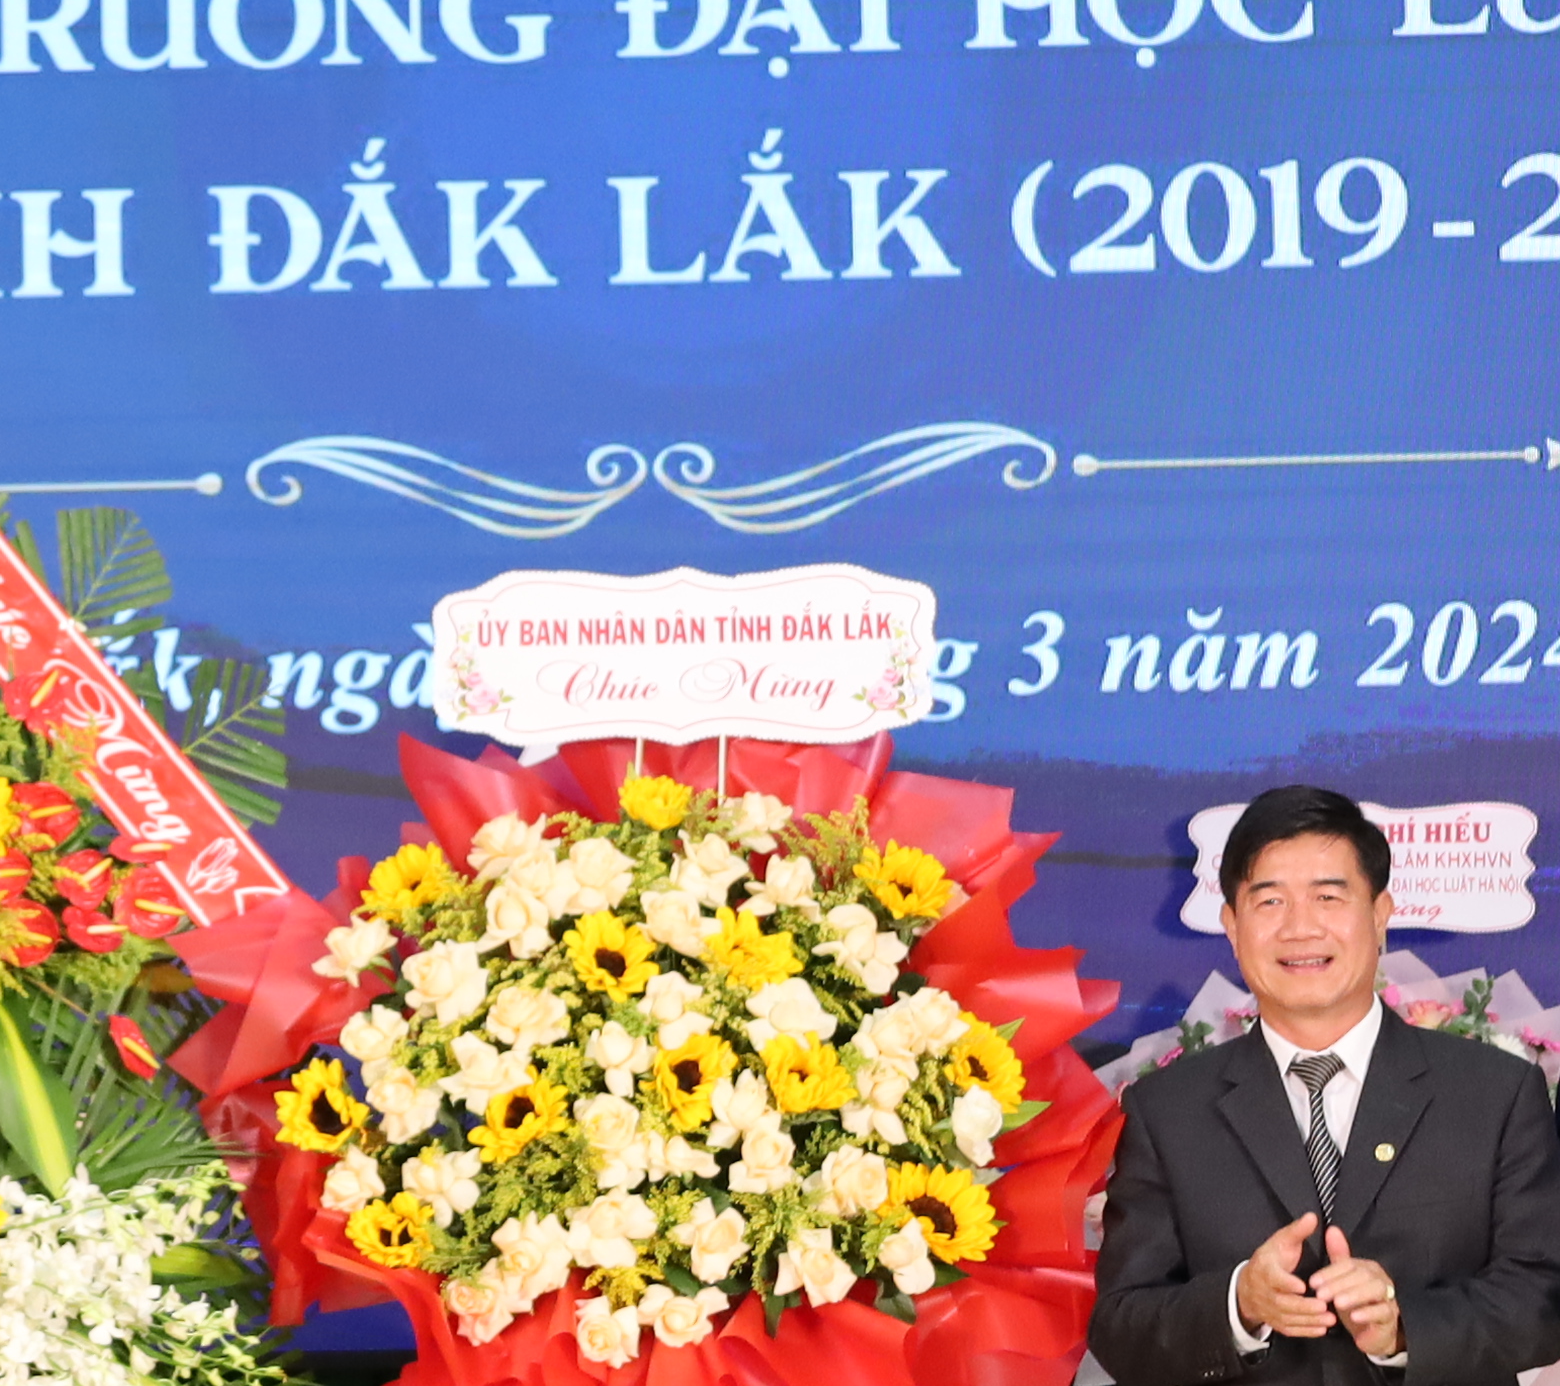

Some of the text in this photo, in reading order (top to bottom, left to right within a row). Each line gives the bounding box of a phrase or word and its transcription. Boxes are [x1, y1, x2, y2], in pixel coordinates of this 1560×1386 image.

[207, 134, 556, 298] ĐẮK
[610, 129, 961, 287] LẮK
[477, 599, 893, 648] ỦY BAN NHÂN DÂN TỈNH ĐẮK LẮK
[260, 622, 456, 735] ngà
[1007, 609, 1066, 696] 3
[1100, 606, 1320, 694] năm
[536, 657, 838, 713] Chúc Mừng
[41, 657, 193, 844] Mừng
[1423, 811, 1492, 844] HIẾU
[1434, 851, 1513, 869] KHXHVN
[1393, 897, 1443, 925] ừng
